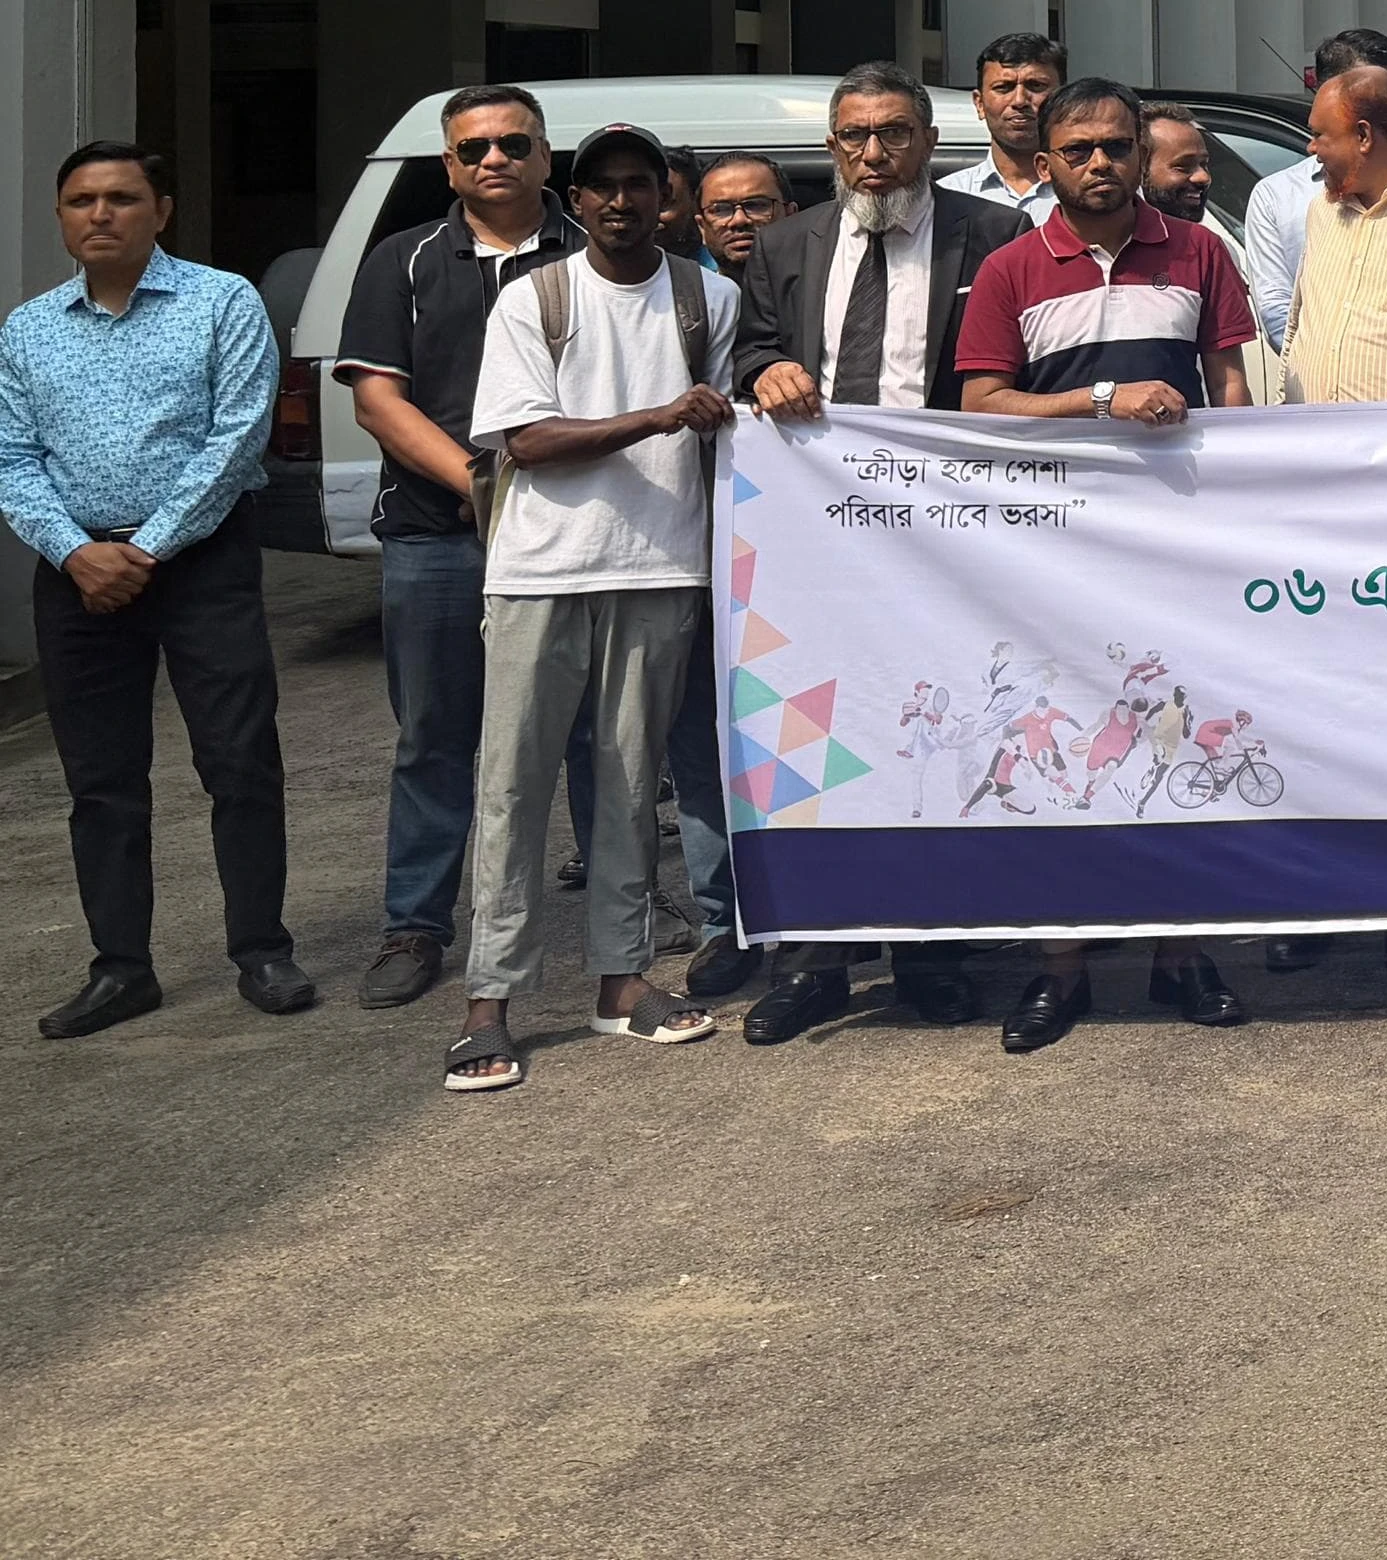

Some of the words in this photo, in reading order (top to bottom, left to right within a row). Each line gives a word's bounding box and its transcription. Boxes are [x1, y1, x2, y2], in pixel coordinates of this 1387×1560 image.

[940, 458, 995, 483] হলে
[1005, 457, 1069, 484] পেশা
[825, 495, 915, 528] পরিবার
[926, 502, 990, 529] পাবে
[1244, 568, 1326, 616] ০৬
